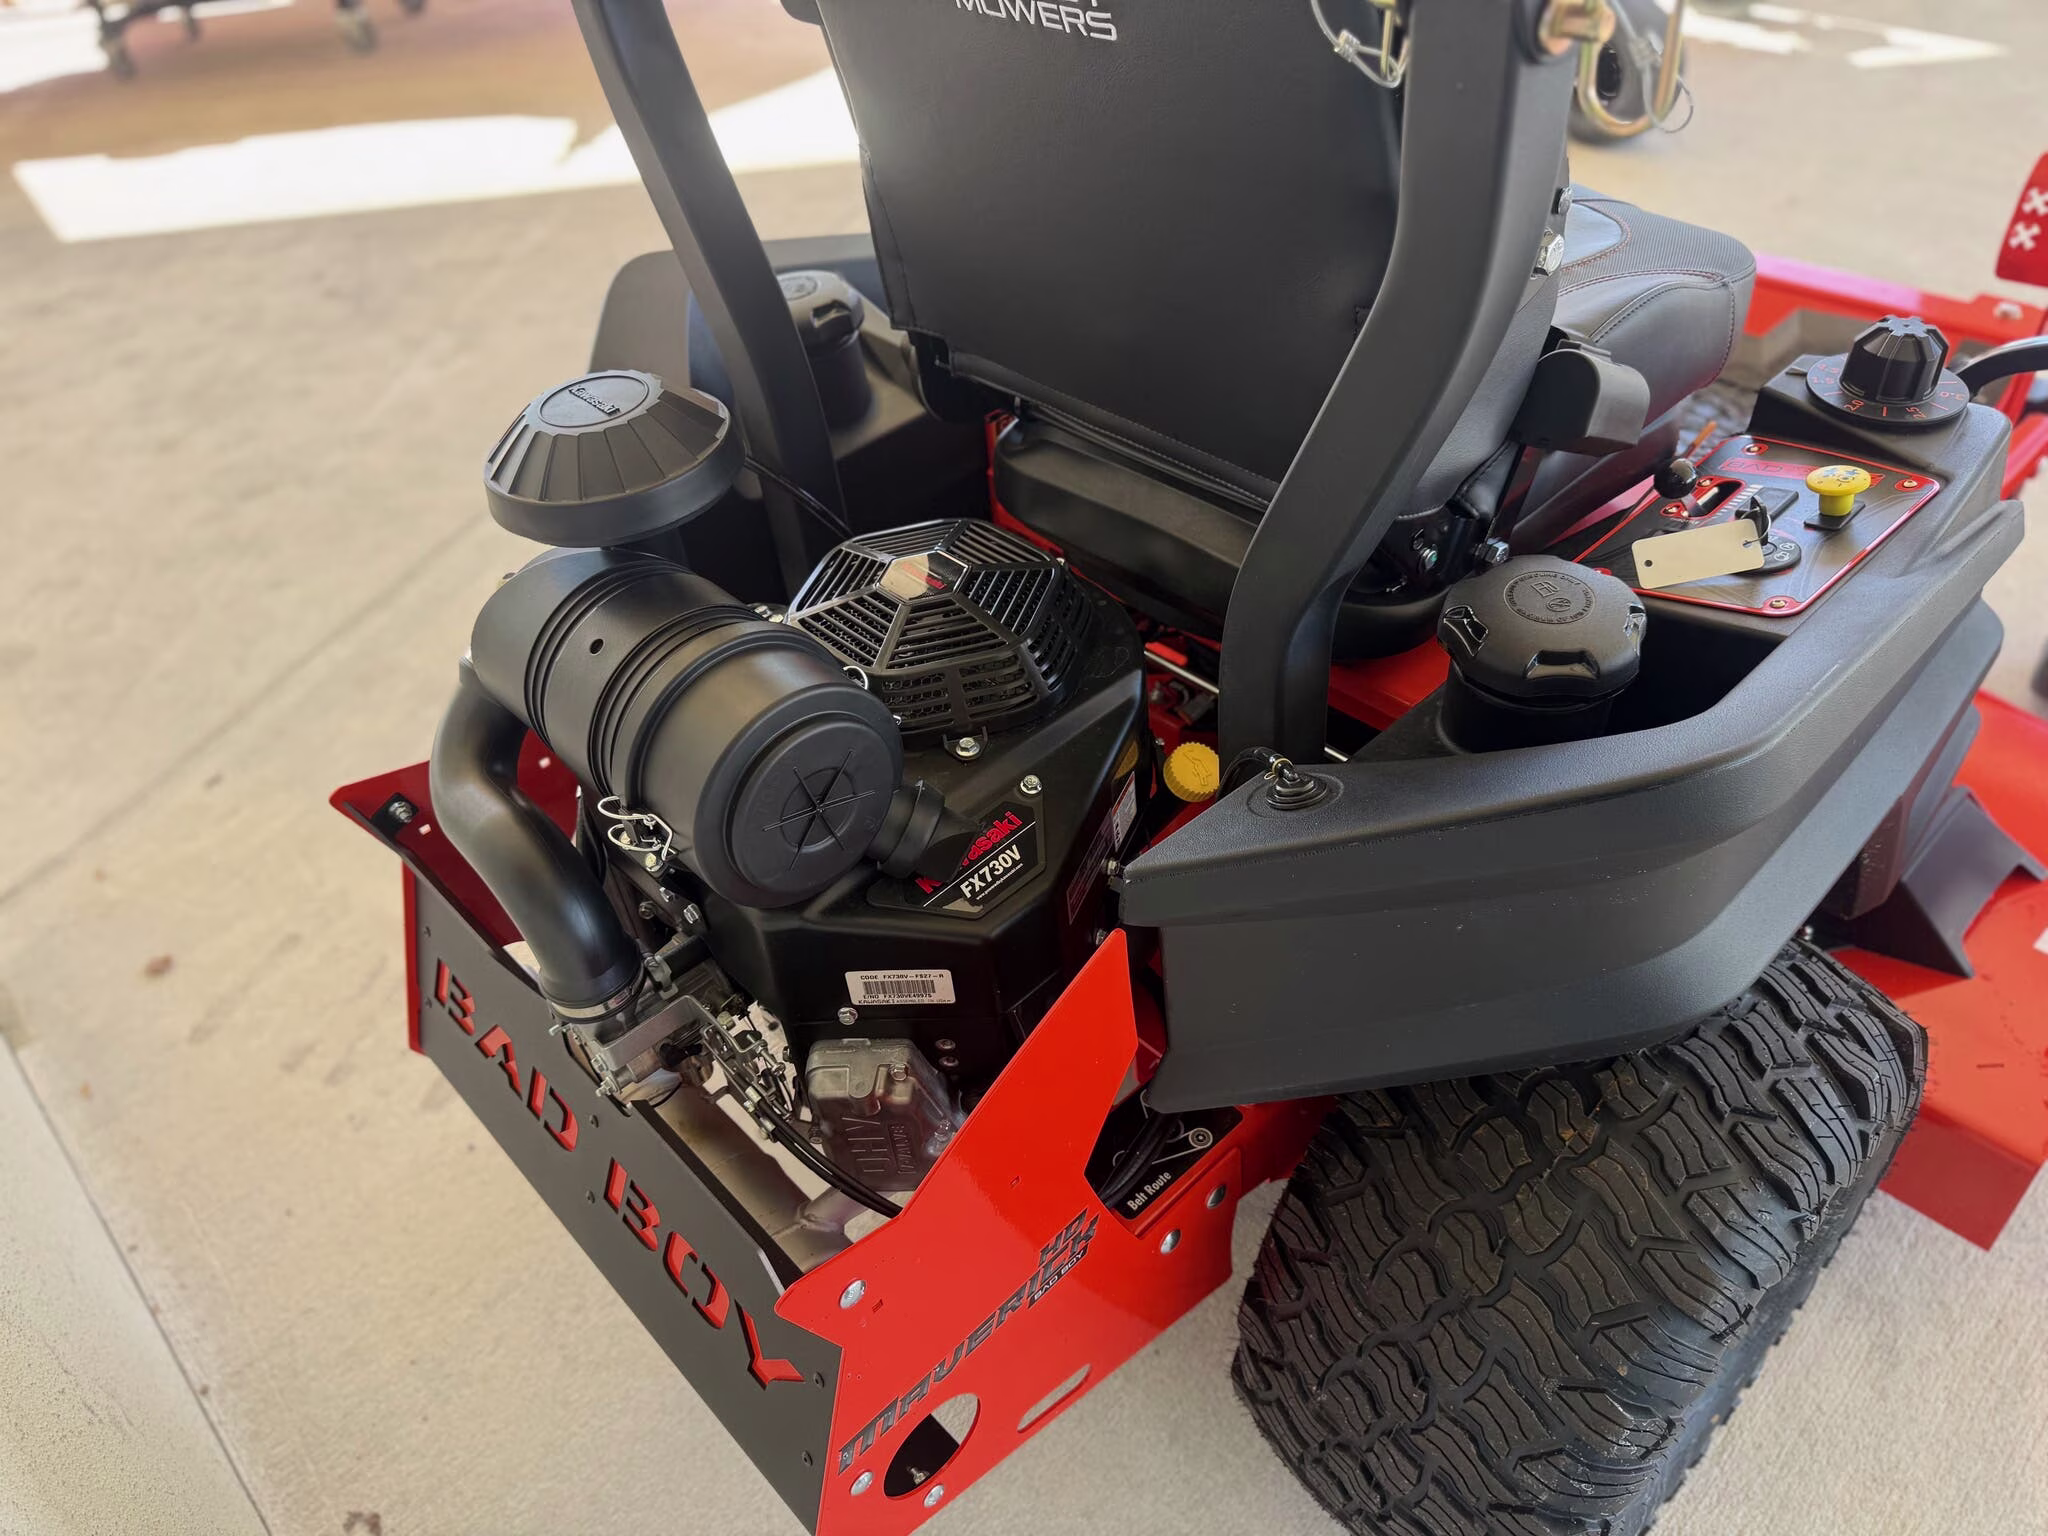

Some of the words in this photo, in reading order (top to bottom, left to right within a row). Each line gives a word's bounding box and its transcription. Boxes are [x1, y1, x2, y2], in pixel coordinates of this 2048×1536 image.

[1844, 399, 1865, 412] 2.0
[915, 811, 1023, 894] Kasaki
[960, 844, 1022, 899] FX730V
[434, 957, 579, 1152] BAD
[604, 1156, 806, 1391] BOY
[1126, 1193, 1149, 1211] Belt
[1143, 1171, 1172, 1196] Route
[1038, 1206, 1089, 1268] HD
[1034, 1275, 1058, 1301] BAD
[1061, 1249, 1084, 1275] BOY
[838, 1212, 1101, 1476] MAVERICK
